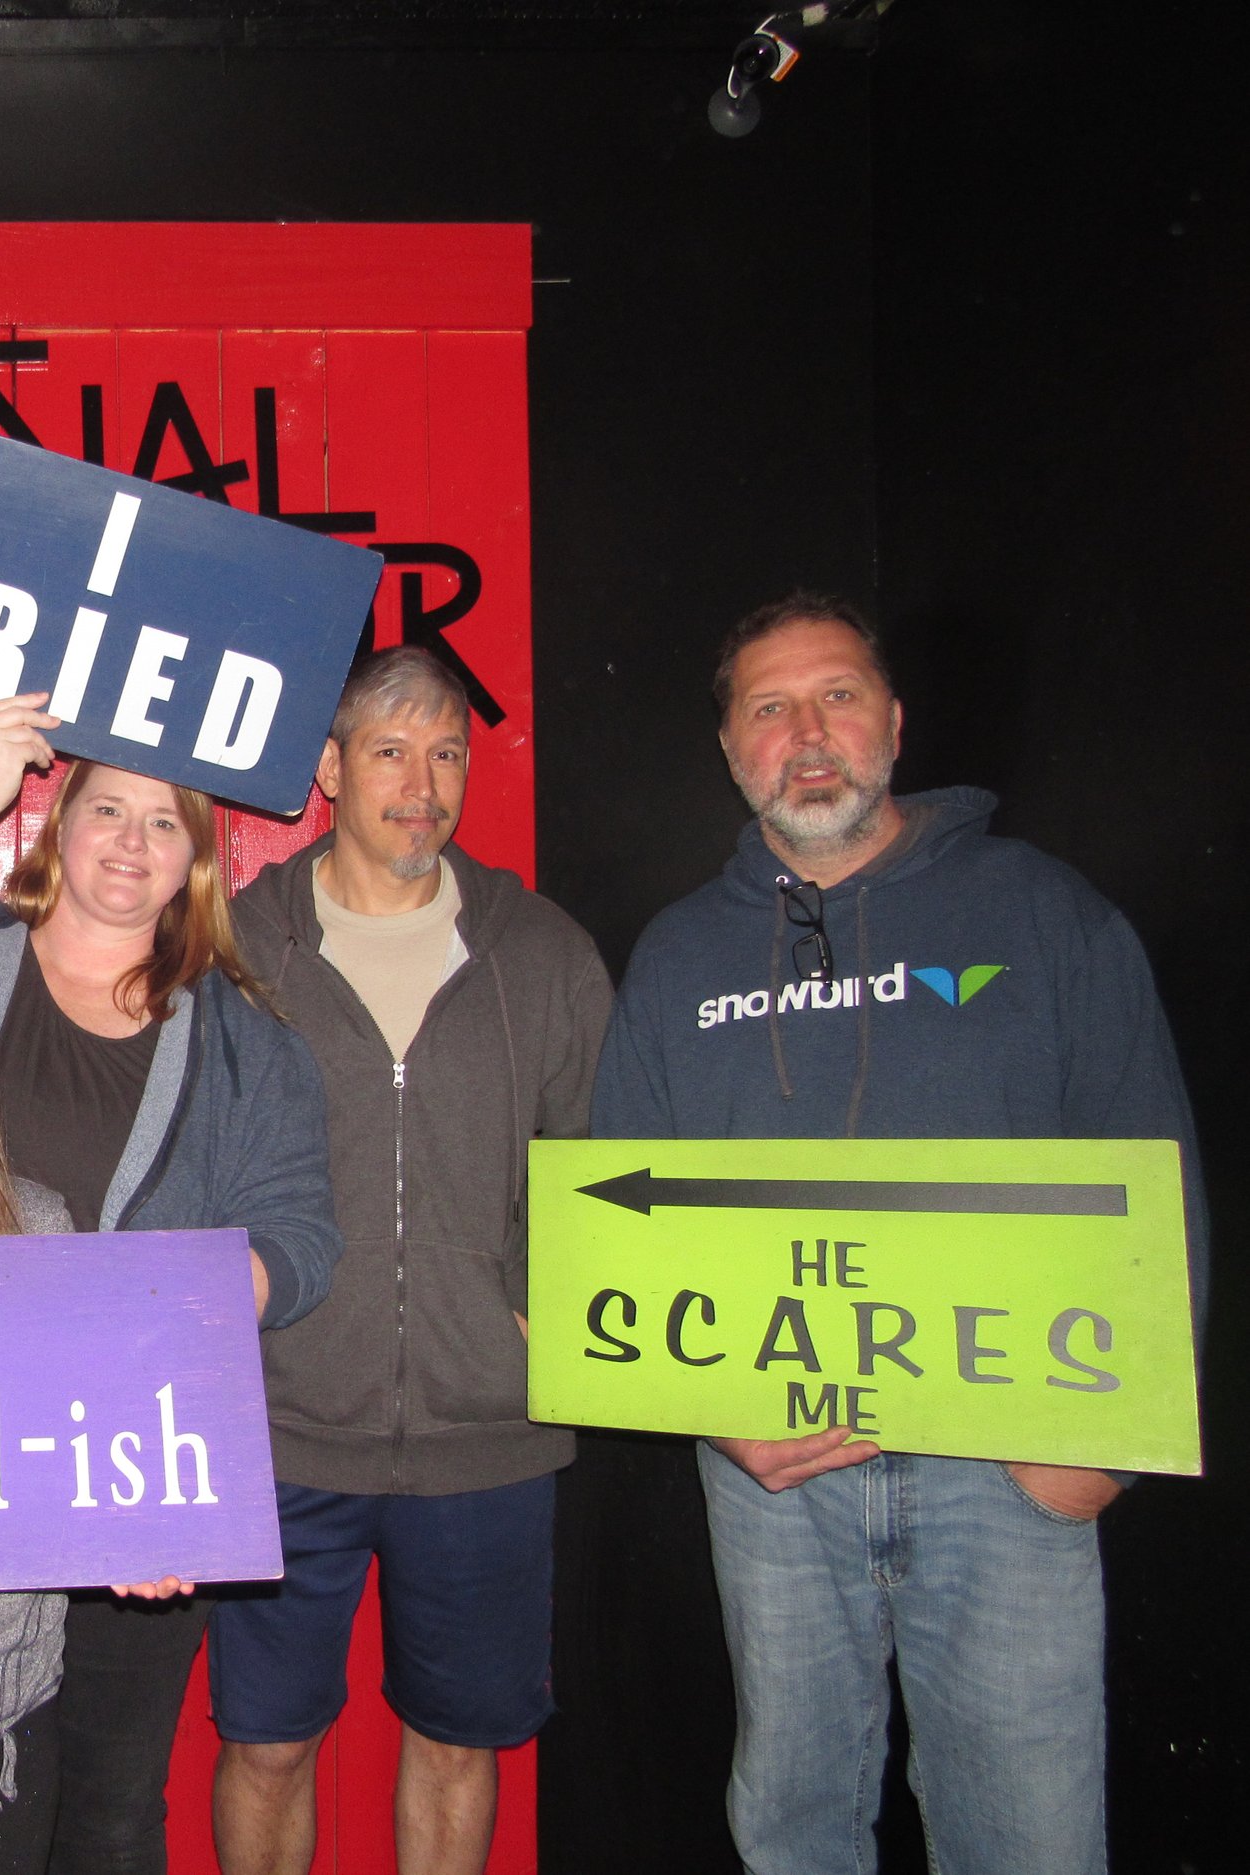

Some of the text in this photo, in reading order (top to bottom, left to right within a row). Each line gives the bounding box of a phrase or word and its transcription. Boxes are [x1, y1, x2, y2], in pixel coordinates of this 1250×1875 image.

[87, 491, 142, 597] I
[791, 1239, 869, 1289] HE
[584, 1288, 1122, 1393] SCARES
[786, 1382, 881, 1435] ME
